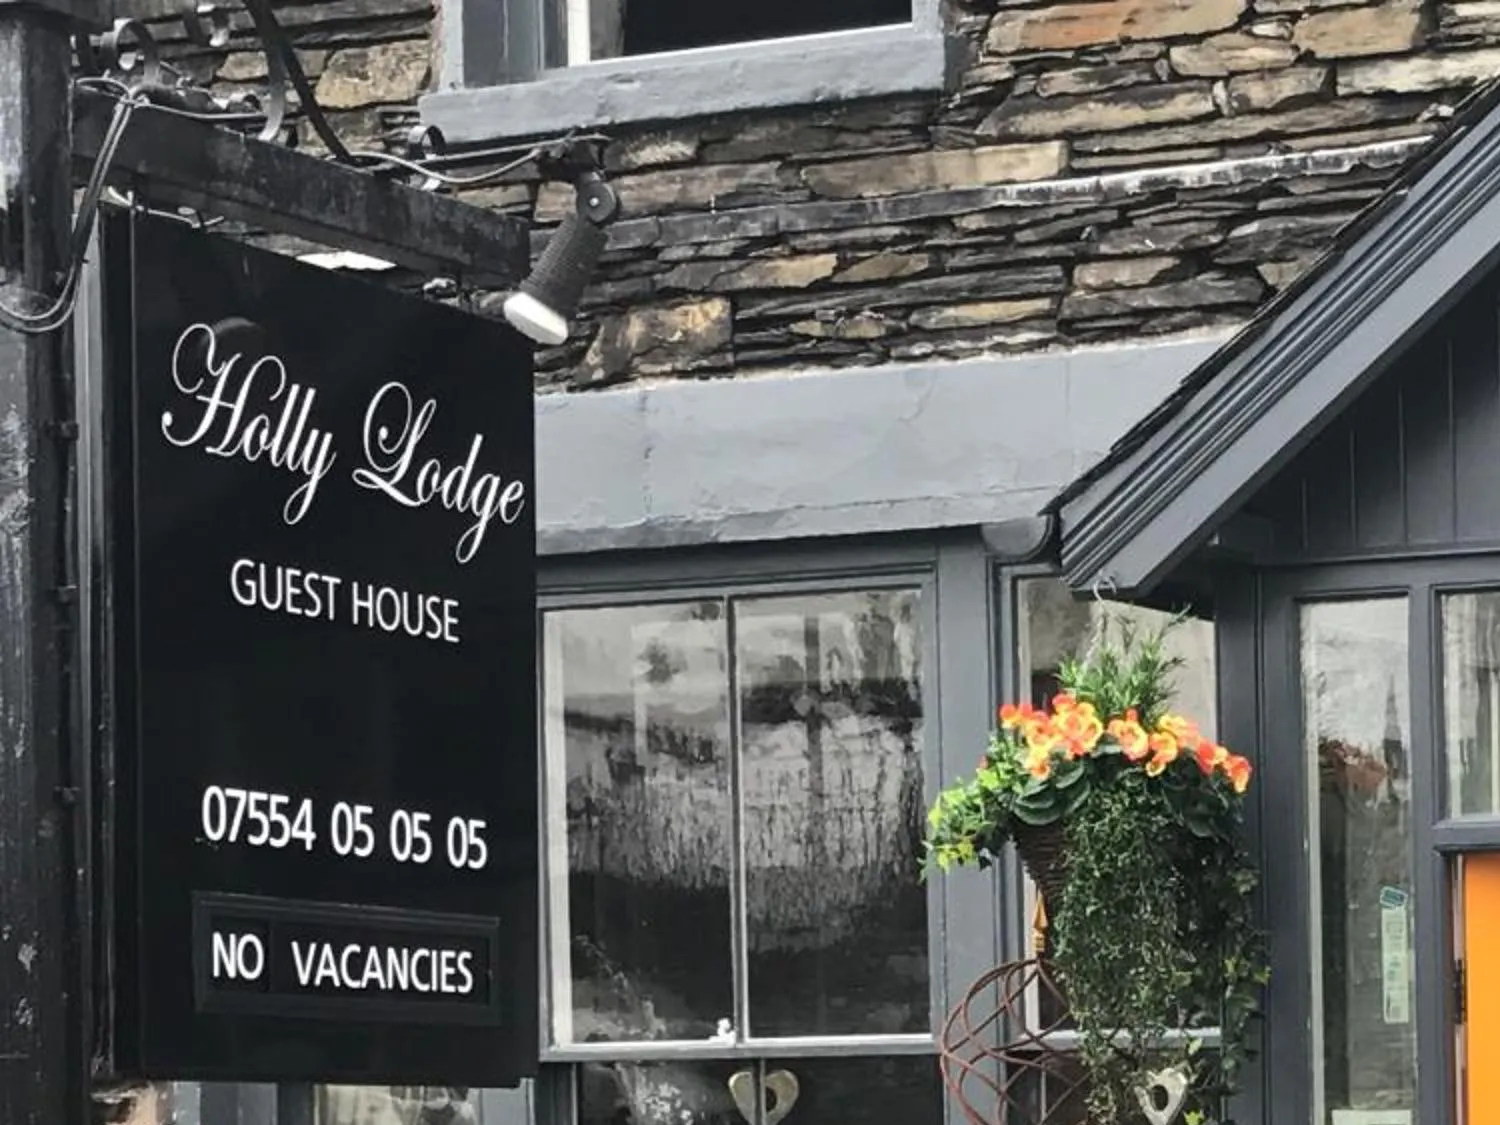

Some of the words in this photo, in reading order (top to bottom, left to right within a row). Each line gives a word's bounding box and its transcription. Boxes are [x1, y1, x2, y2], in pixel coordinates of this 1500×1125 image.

[162, 323, 336, 525] Holly
[352, 381, 525, 563] Lodge
[230, 558, 341, 621] GUEST
[352, 581, 460, 643] HOUSE
[202, 785, 317, 851] 07554
[330, 801, 375, 857] 05
[389, 809, 433, 864] 05
[446, 815, 488, 870] 05
[212, 931, 265, 980] NO
[291, 940, 473, 994] VACANCIES
